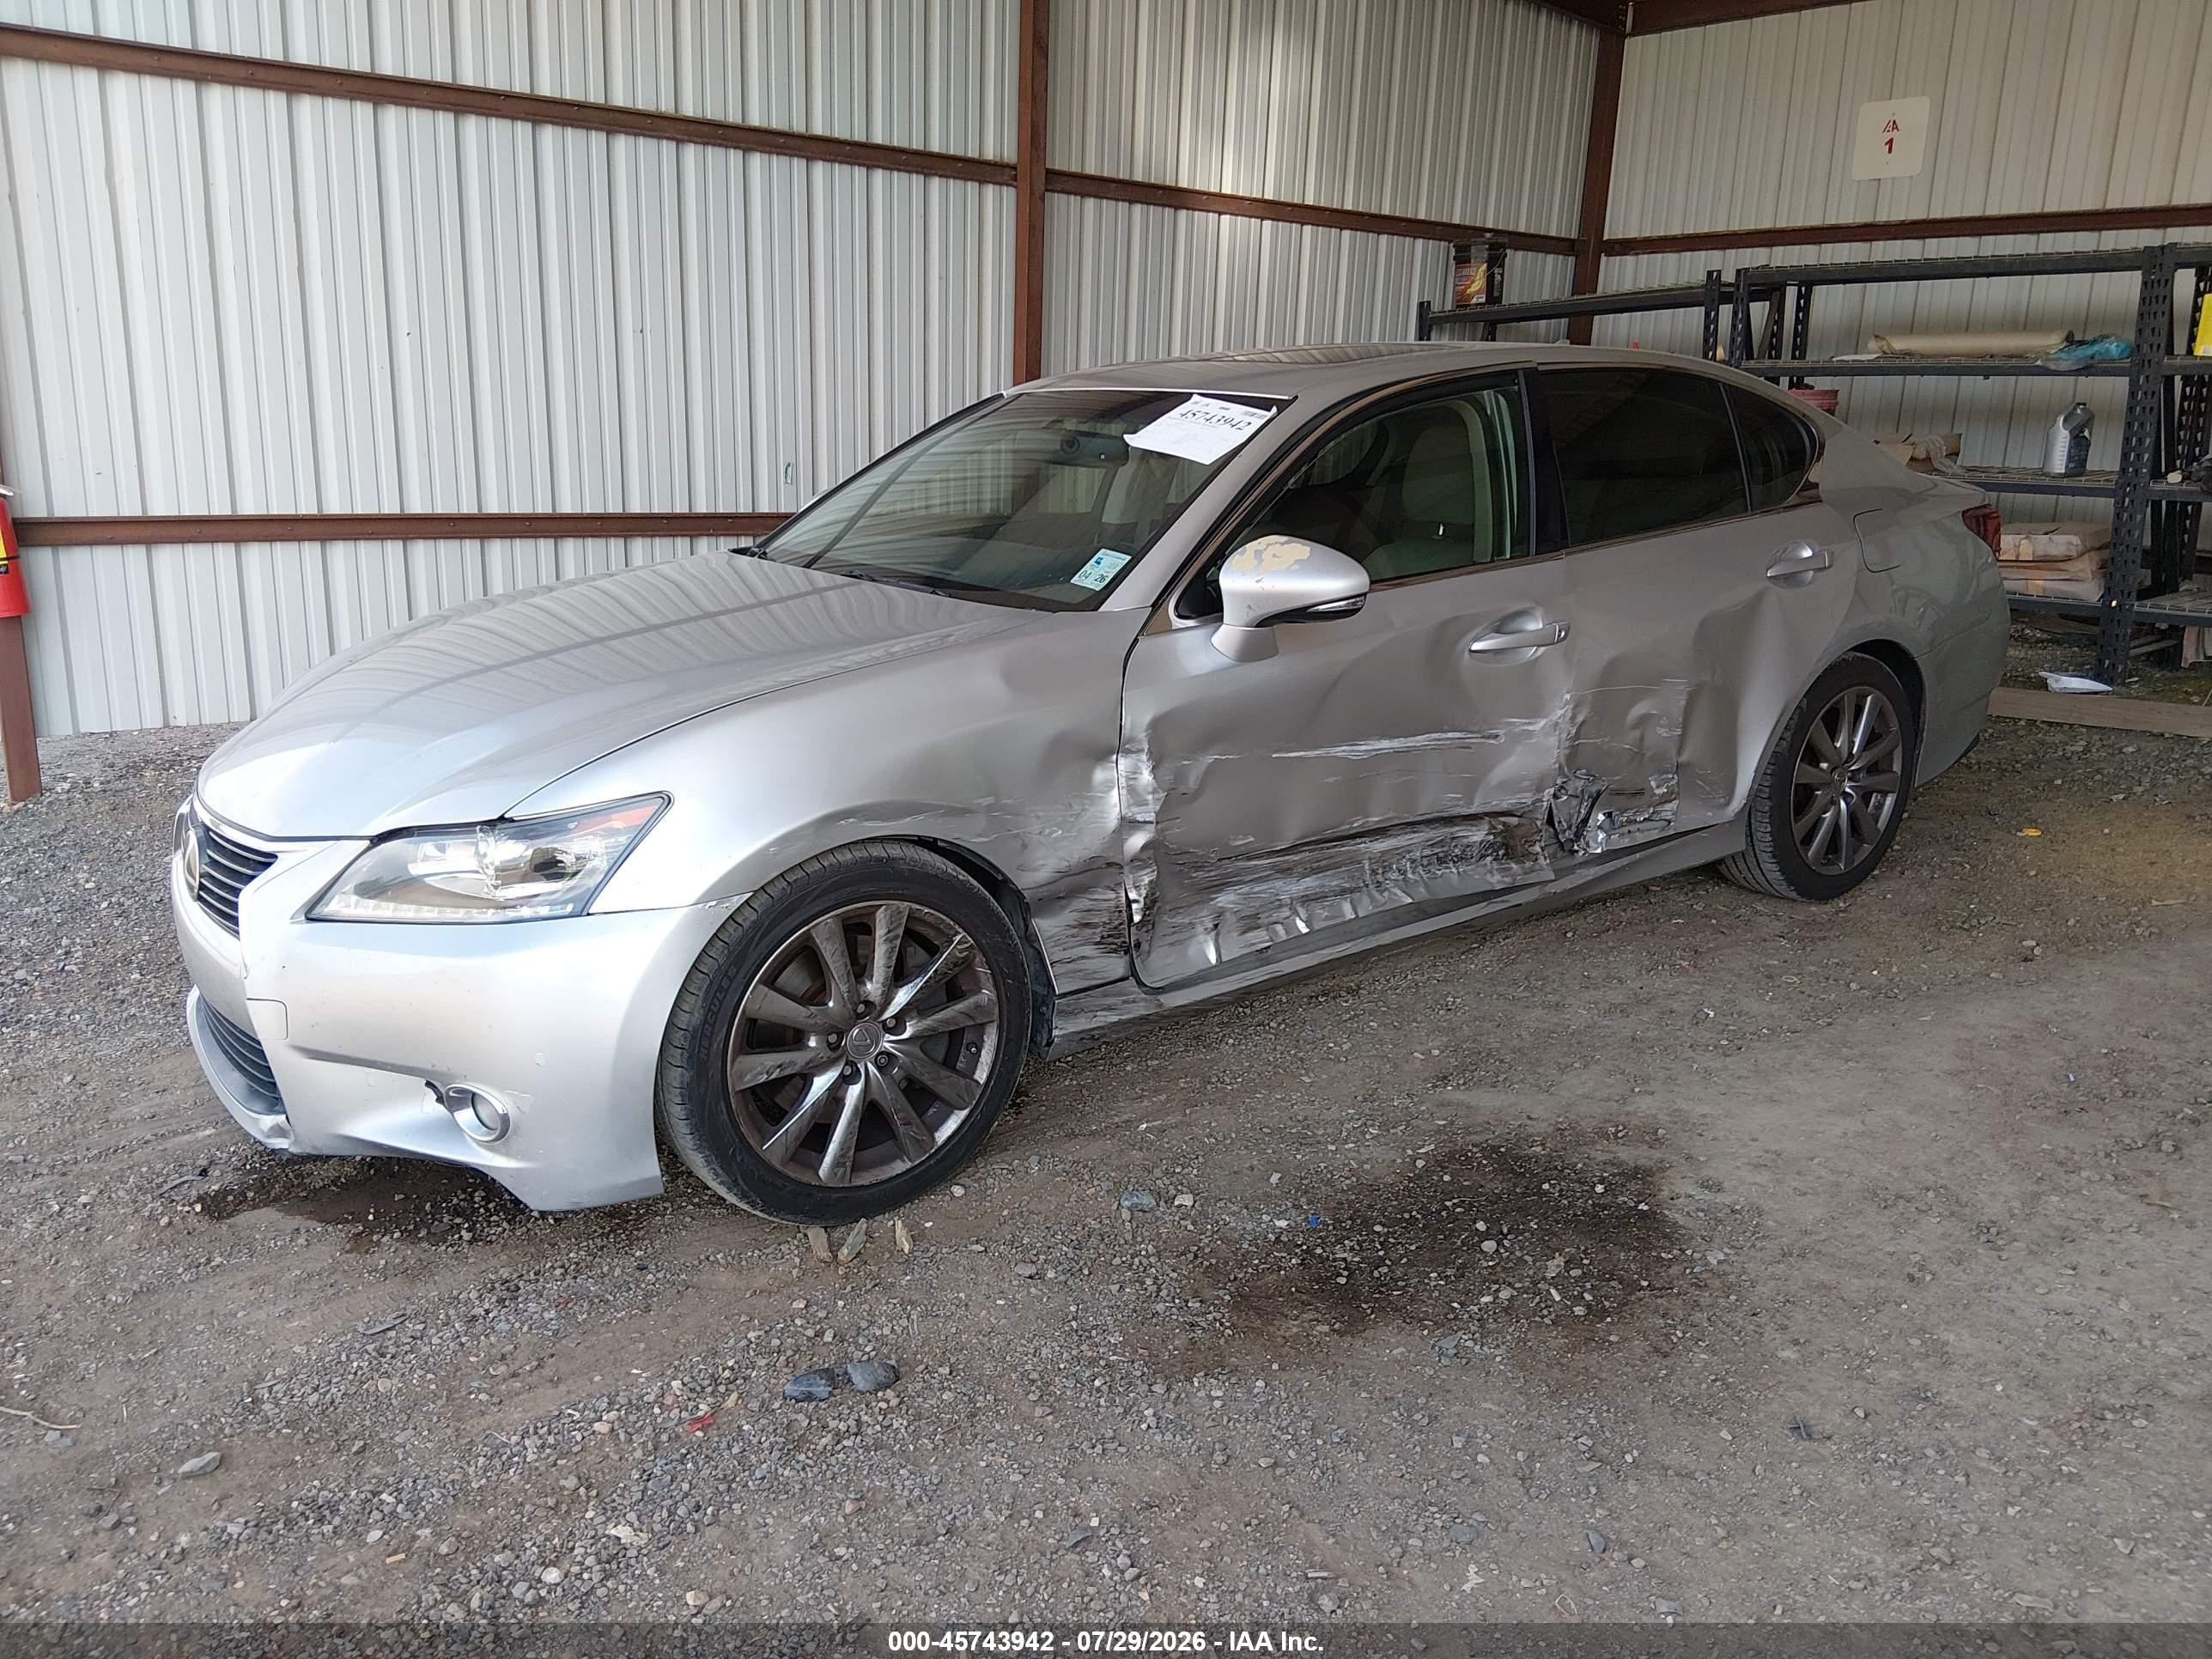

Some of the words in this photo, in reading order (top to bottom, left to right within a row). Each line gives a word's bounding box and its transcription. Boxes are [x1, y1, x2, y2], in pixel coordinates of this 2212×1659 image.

[1884, 137, 1894, 154] 1
[1179, 409, 1252, 431] 45743942
[1094, 574, 1109, 584] 26
[699, 965, 738, 1062] HERCULES
